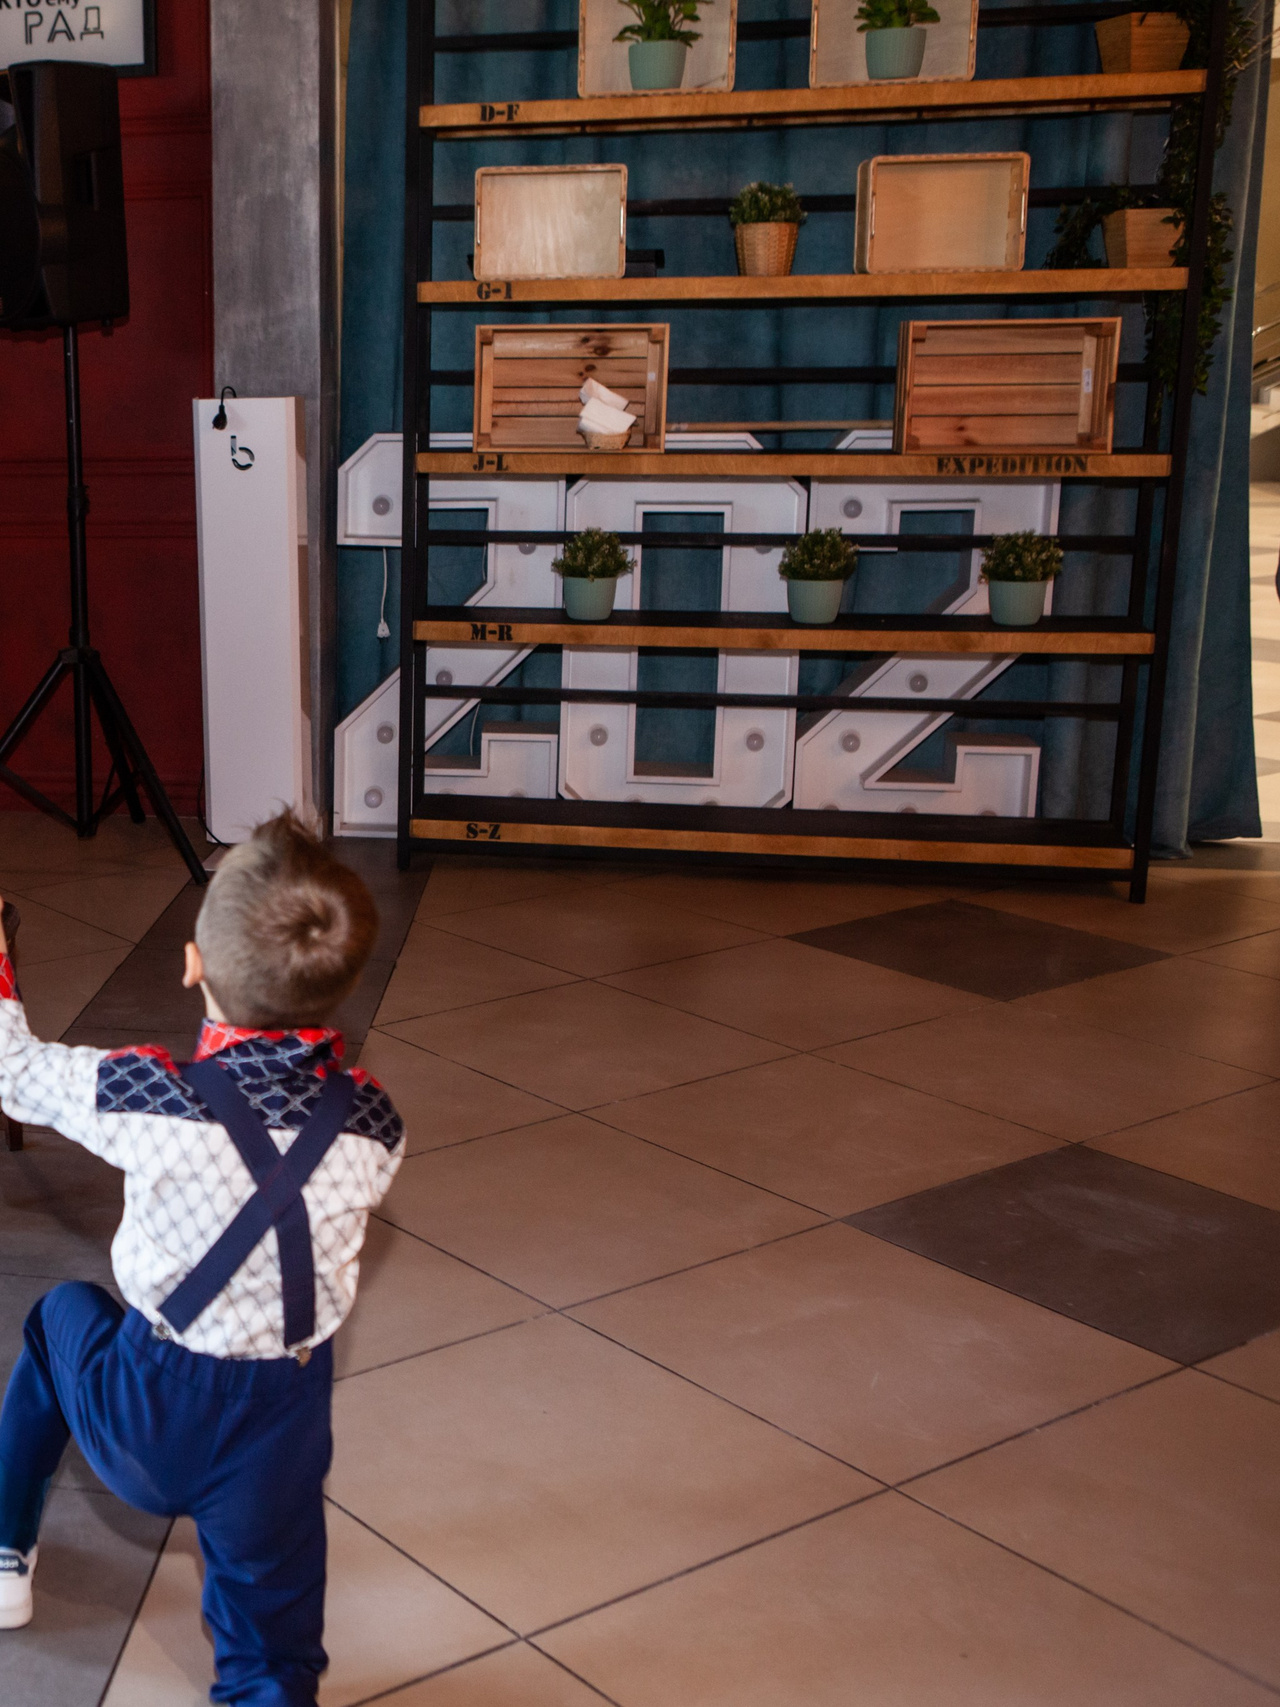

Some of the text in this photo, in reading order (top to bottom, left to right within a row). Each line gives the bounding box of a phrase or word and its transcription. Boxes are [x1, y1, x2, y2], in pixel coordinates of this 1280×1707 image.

[24, 6, 104, 45] РАД
[480, 103, 520, 122] D-F
[472, 454, 509, 472] J-L
[936, 455, 1089, 474] EXPEDITION
[470, 623, 514, 641] M-R
[465, 822, 502, 840] S-Z
